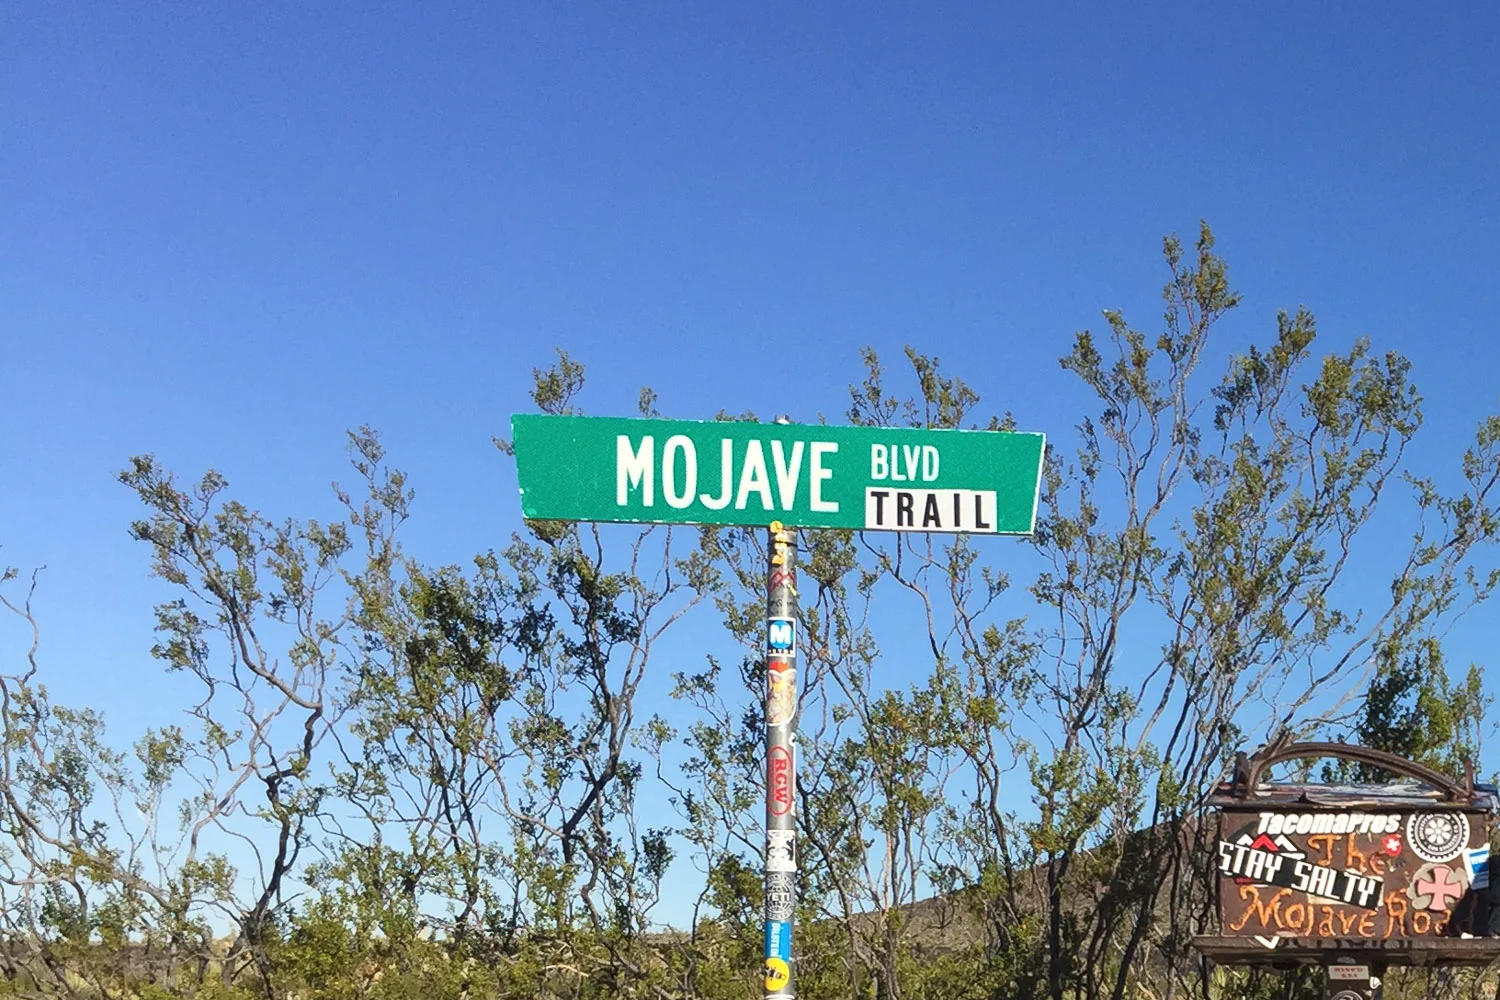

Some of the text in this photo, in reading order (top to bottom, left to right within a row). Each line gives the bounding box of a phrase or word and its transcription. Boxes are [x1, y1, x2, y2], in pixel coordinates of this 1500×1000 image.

[615, 434, 940, 513] MOJAVE BLVD
[870, 490, 992, 530] TRAIL
[1218, 841, 1376, 907] STAY SALTY
[1307, 832, 1385, 875] The
[1229, 885, 1377, 937] Mojave
